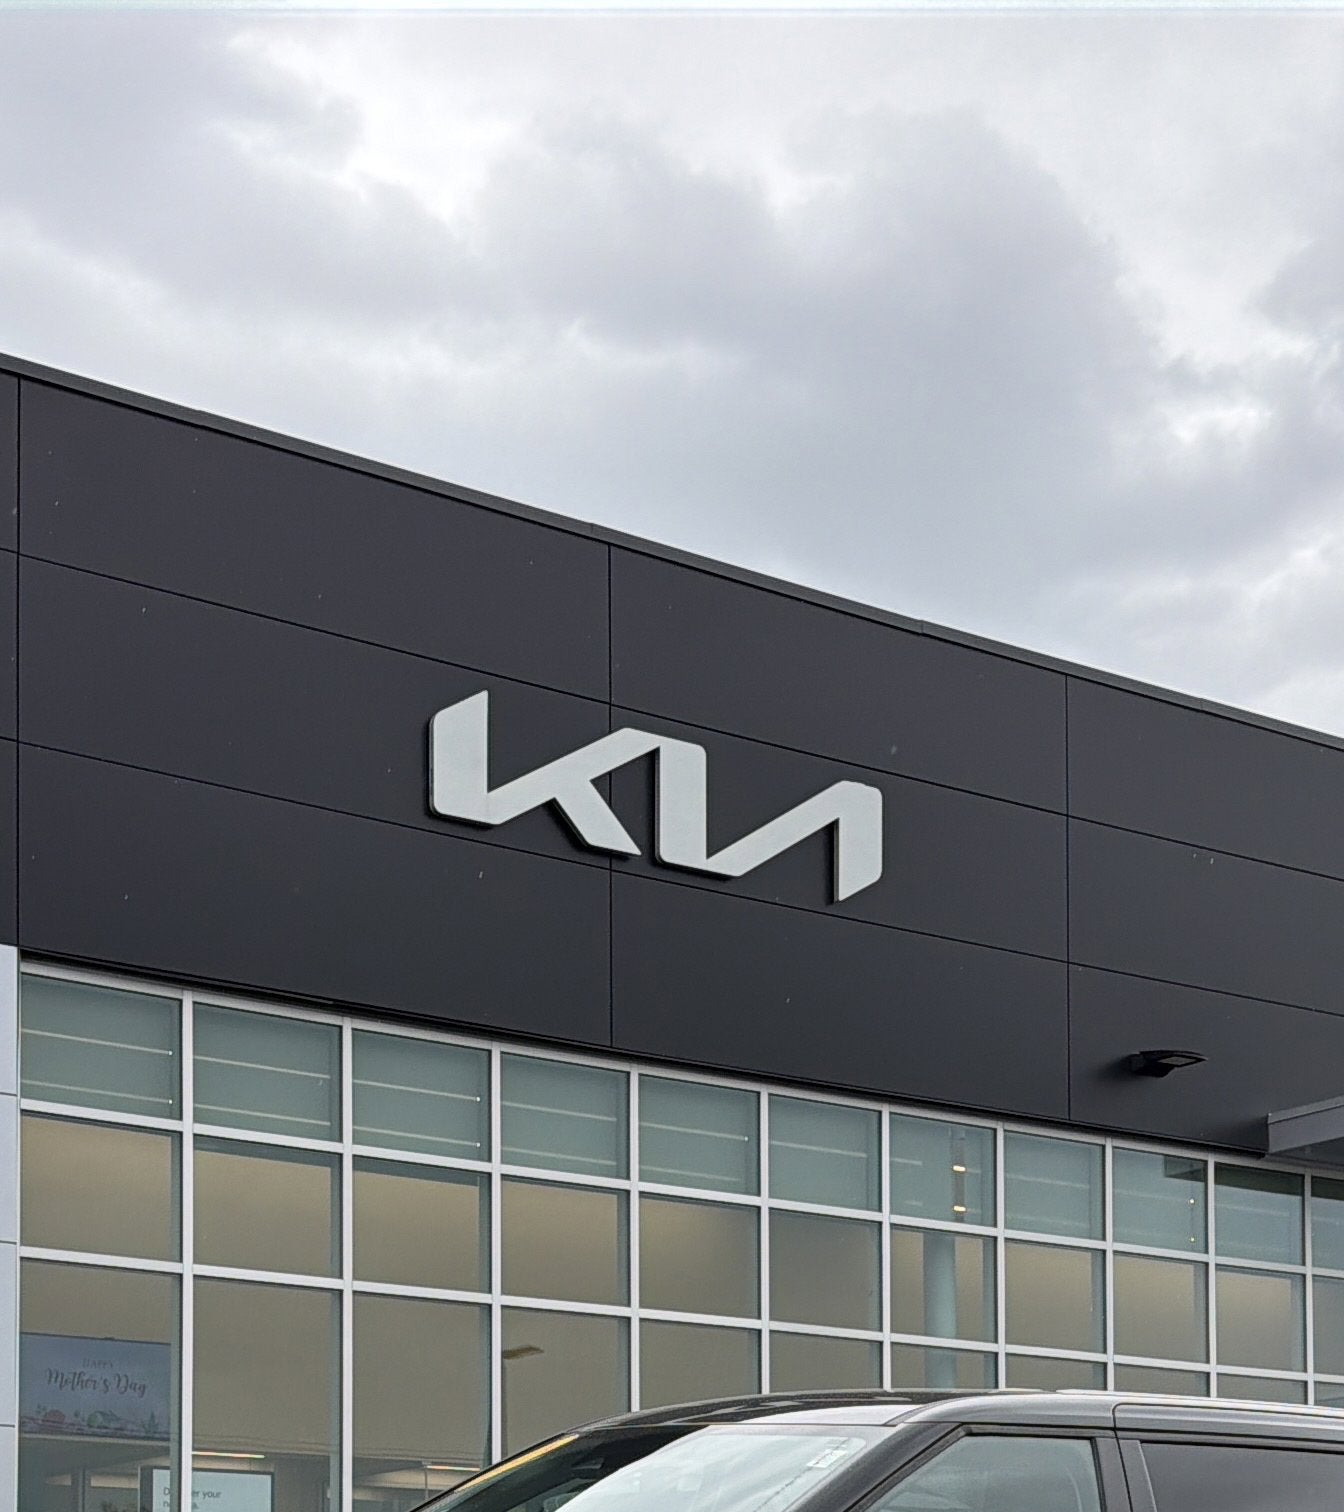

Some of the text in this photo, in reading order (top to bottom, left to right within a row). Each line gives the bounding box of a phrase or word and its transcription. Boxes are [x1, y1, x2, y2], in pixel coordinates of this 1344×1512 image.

[45, 1367, 146, 1399] Mother's Day
[202, 1490, 223, 1499] your
